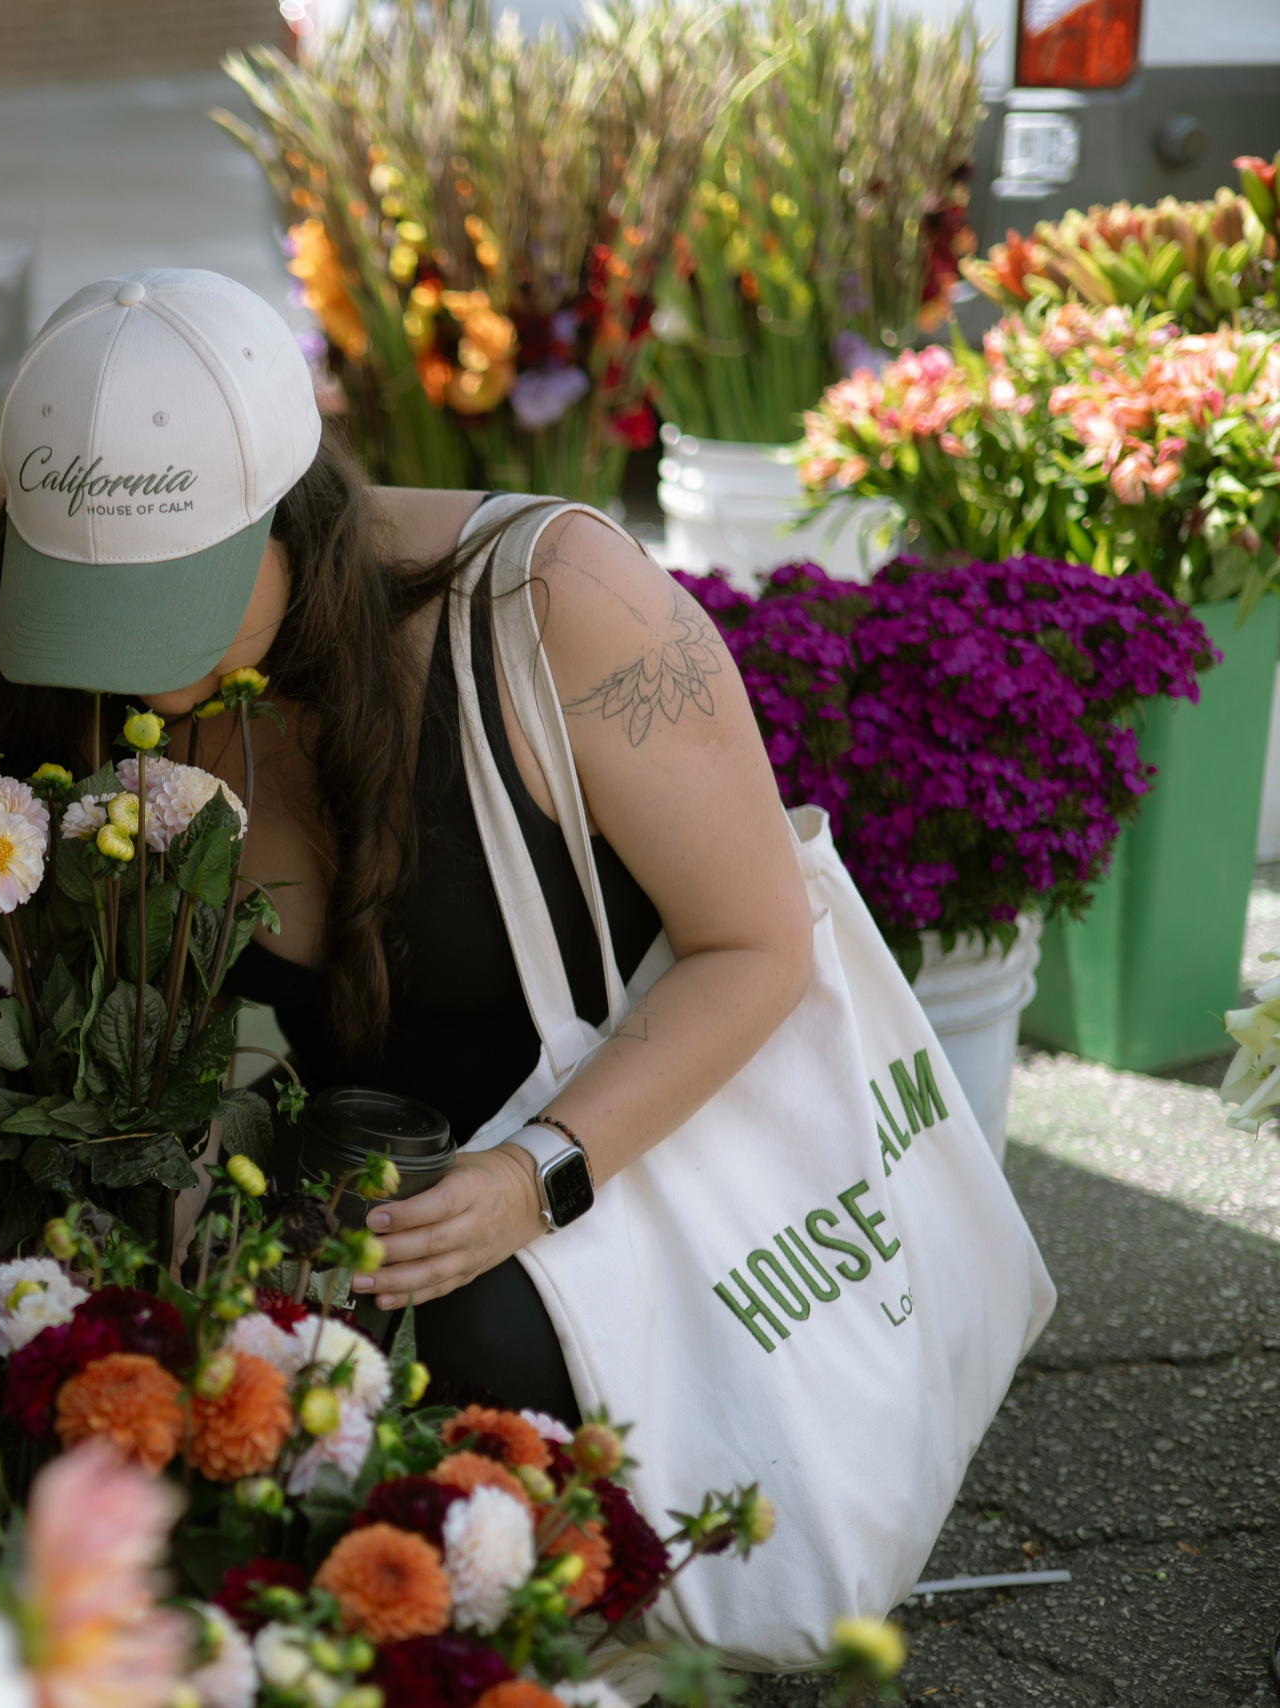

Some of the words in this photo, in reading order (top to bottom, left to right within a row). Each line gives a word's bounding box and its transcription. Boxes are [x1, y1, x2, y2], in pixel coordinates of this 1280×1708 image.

[19, 445, 198, 517] California
[87, 505, 132, 516] HOUSE
[136, 504, 154, 515] OF
[158, 500, 193, 513] CALM
[713, 1179, 901, 1353] HOUSE
[869, 1048, 949, 1177] ALM
[880, 1285, 913, 1327] Lo
